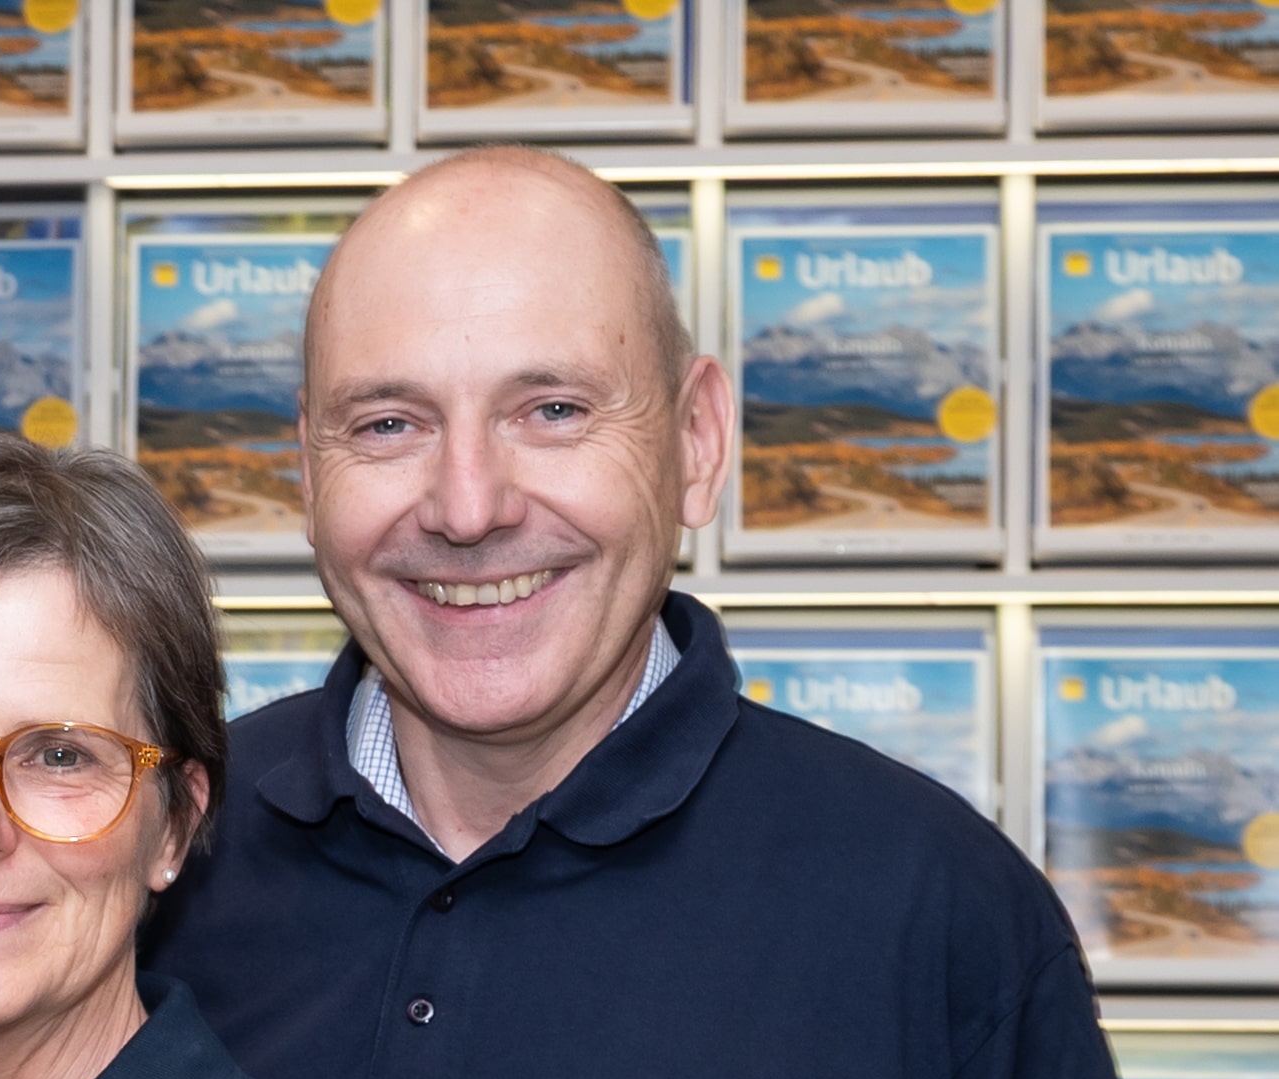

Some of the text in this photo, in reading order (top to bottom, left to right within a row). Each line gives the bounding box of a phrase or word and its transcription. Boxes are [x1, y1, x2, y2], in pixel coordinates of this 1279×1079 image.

[796, 251, 933, 289] Urlaub
[1104, 247, 1243, 286] Urlaub
[786, 674, 923, 712] Urlaub
[1099, 673, 1238, 711] Urlaub
